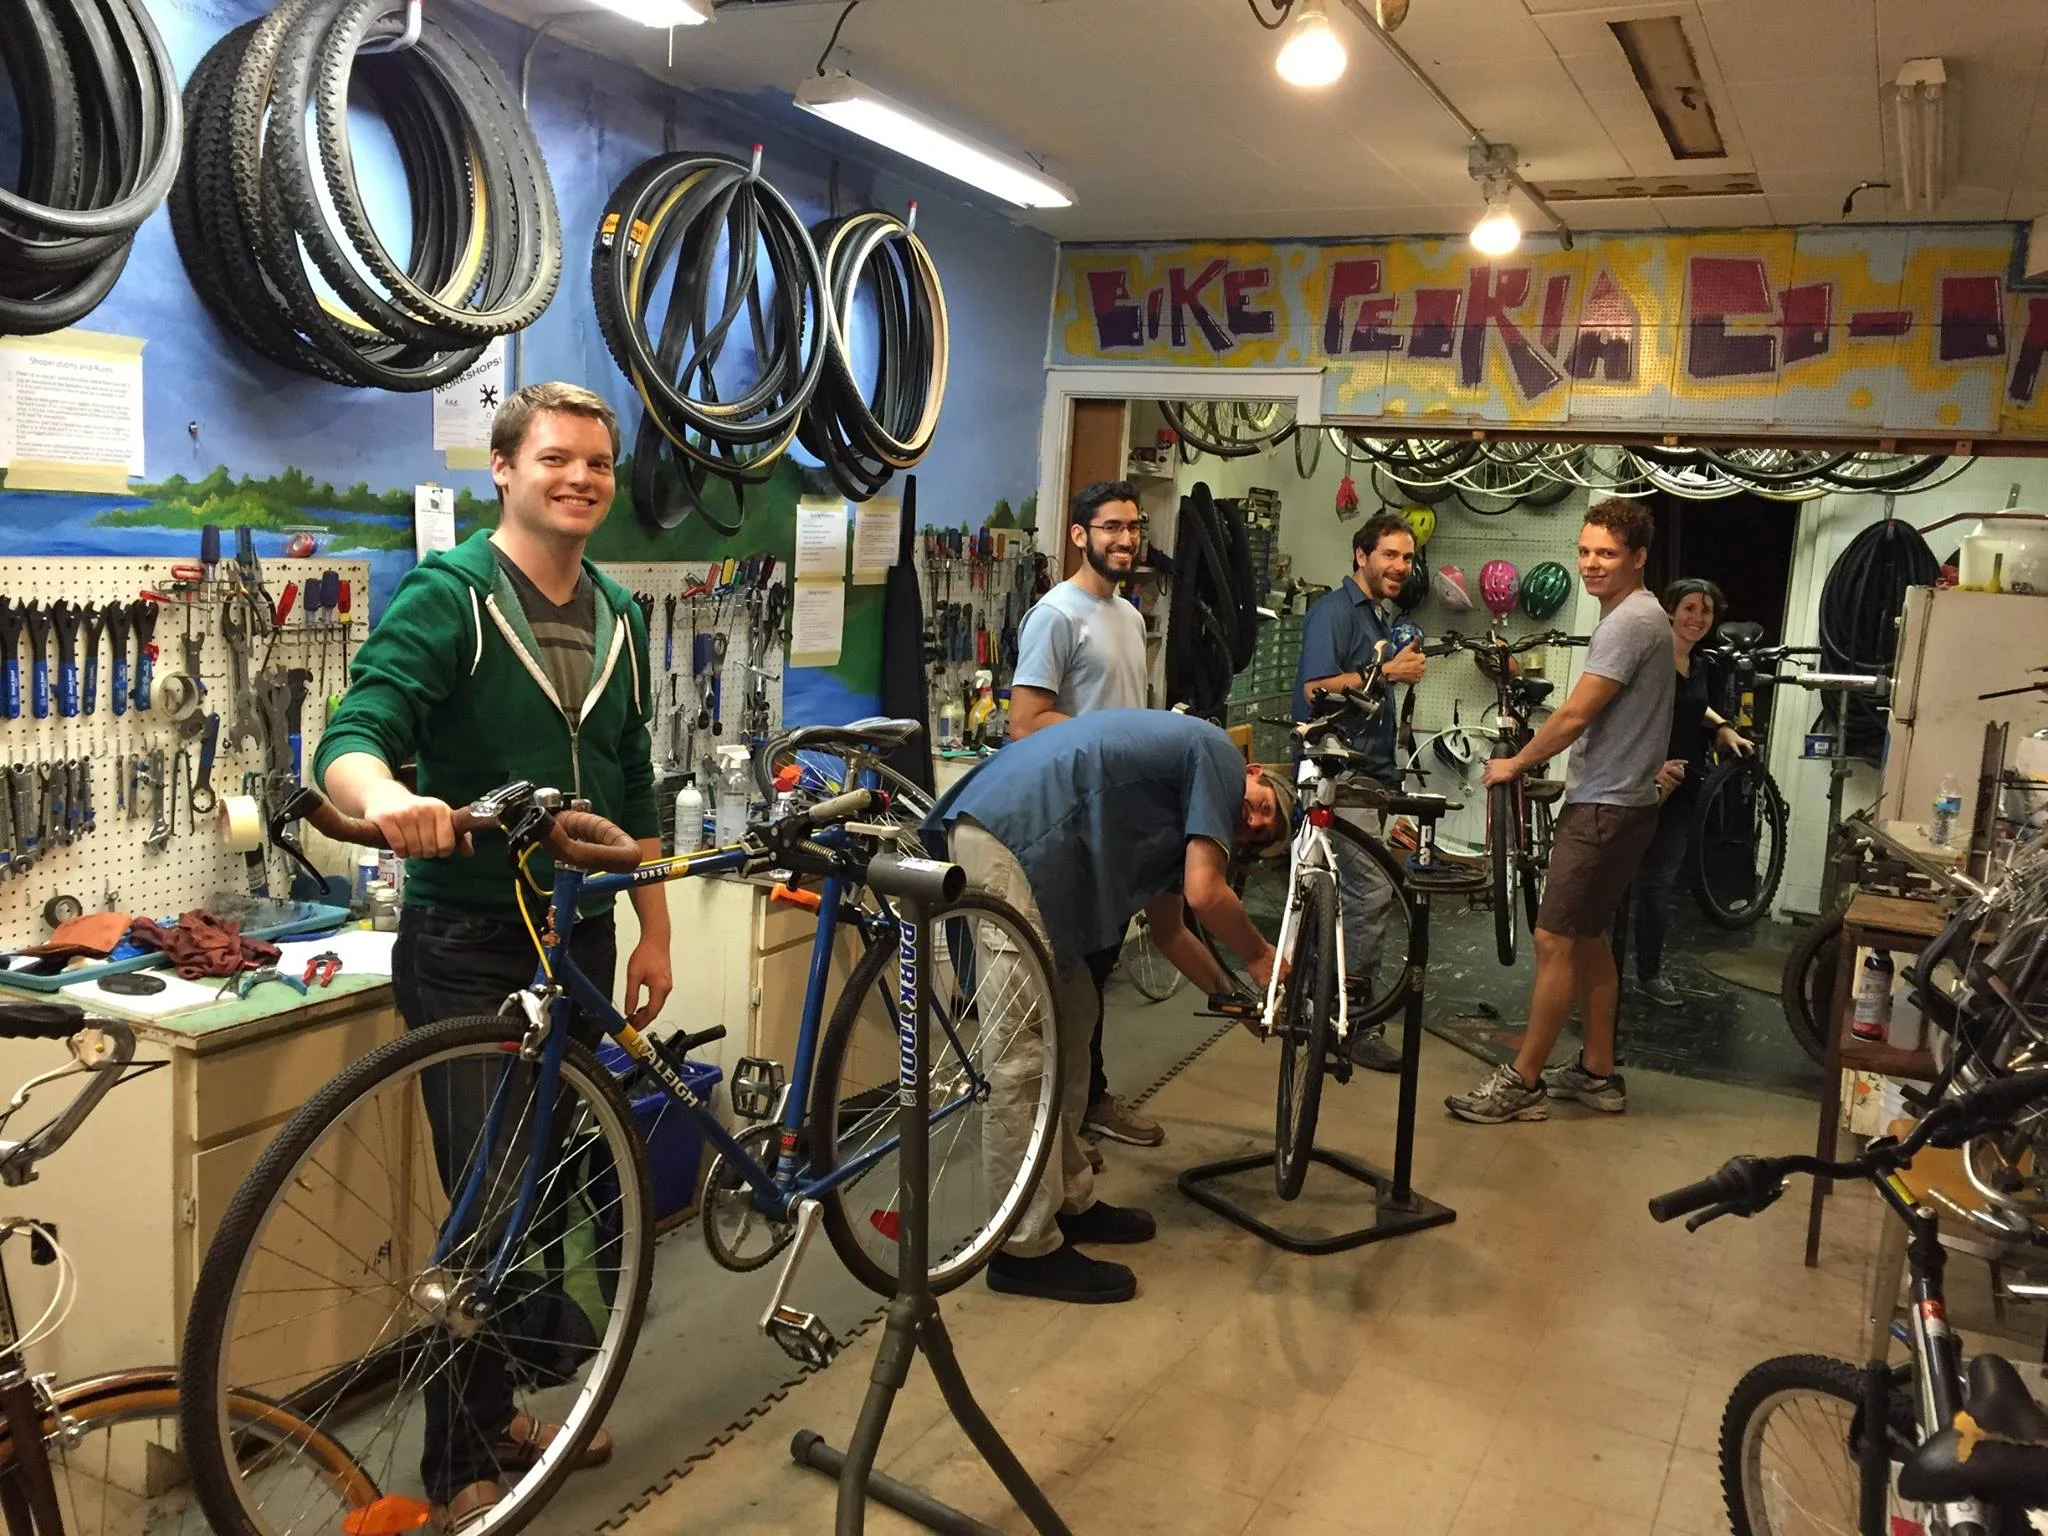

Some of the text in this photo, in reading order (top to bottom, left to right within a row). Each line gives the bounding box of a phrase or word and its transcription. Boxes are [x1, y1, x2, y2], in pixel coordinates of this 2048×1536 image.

[633, 861, 684, 881] PURSU
[899, 920, 918, 1010] PARK
[630, 1035, 699, 1107] RALEIGH
[899, 1011, 919, 1086] TOOL
